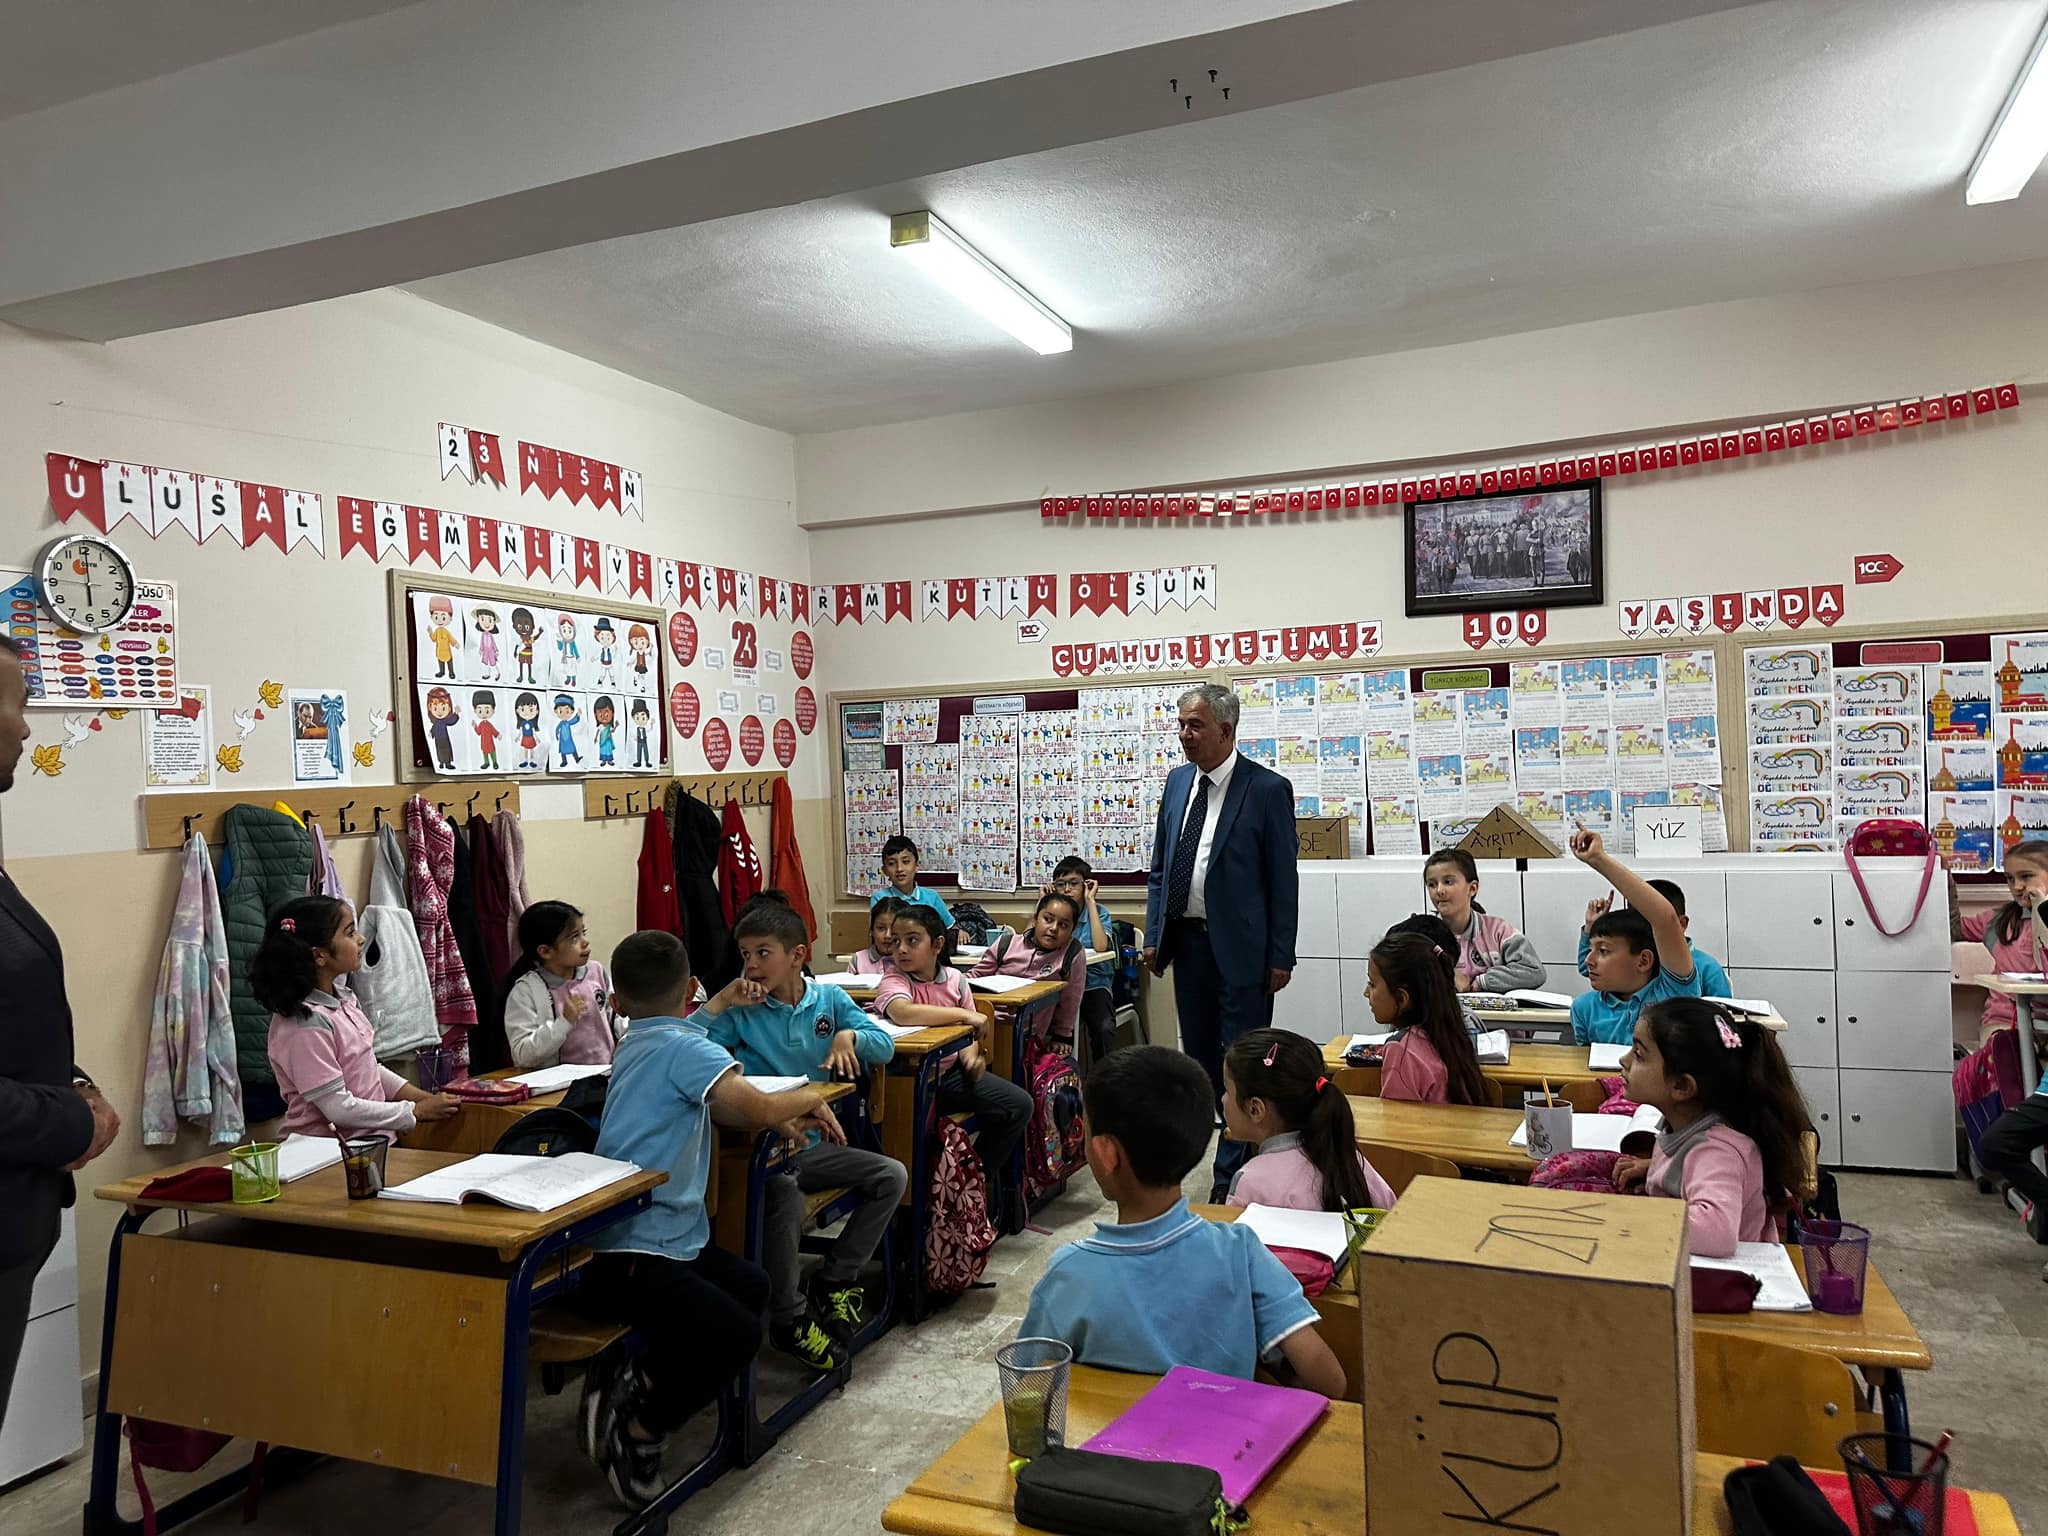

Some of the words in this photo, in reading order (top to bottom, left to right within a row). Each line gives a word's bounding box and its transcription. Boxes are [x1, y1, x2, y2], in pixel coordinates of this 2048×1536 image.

[448, 439, 490, 463] 23
[527, 455, 635, 498] NİSAN
[65, 473, 308, 527] ULUSAL
[352, 514, 593, 572] EGEMENLİK
[612, 558, 645, 580] VE
[665, 570, 748, 598] ÇOCUK
[930, 584, 1049, 603] KUTLU
[1078, 577, 1206, 598] OLSUN
[53, 562, 62, 571] 10
[108, 565, 117, 574] 2
[115, 582, 123, 591] 3
[55, 595, 65, 604] 8
[69, 608, 76, 617] 7
[101, 609, 110, 618] 5
[85, 613, 94, 622] 6
[1056, 625, 1377, 667] CUMHURİYETİMİZ
[1469, 613, 1540, 637] 100
[1624, 591, 1838, 626] YAŞINDA
[1646, 818, 1687, 840] YÜZ
[1470, 831, 1516, 848] AYRIT
[1415, 1332, 1563, 1536] KÜP
